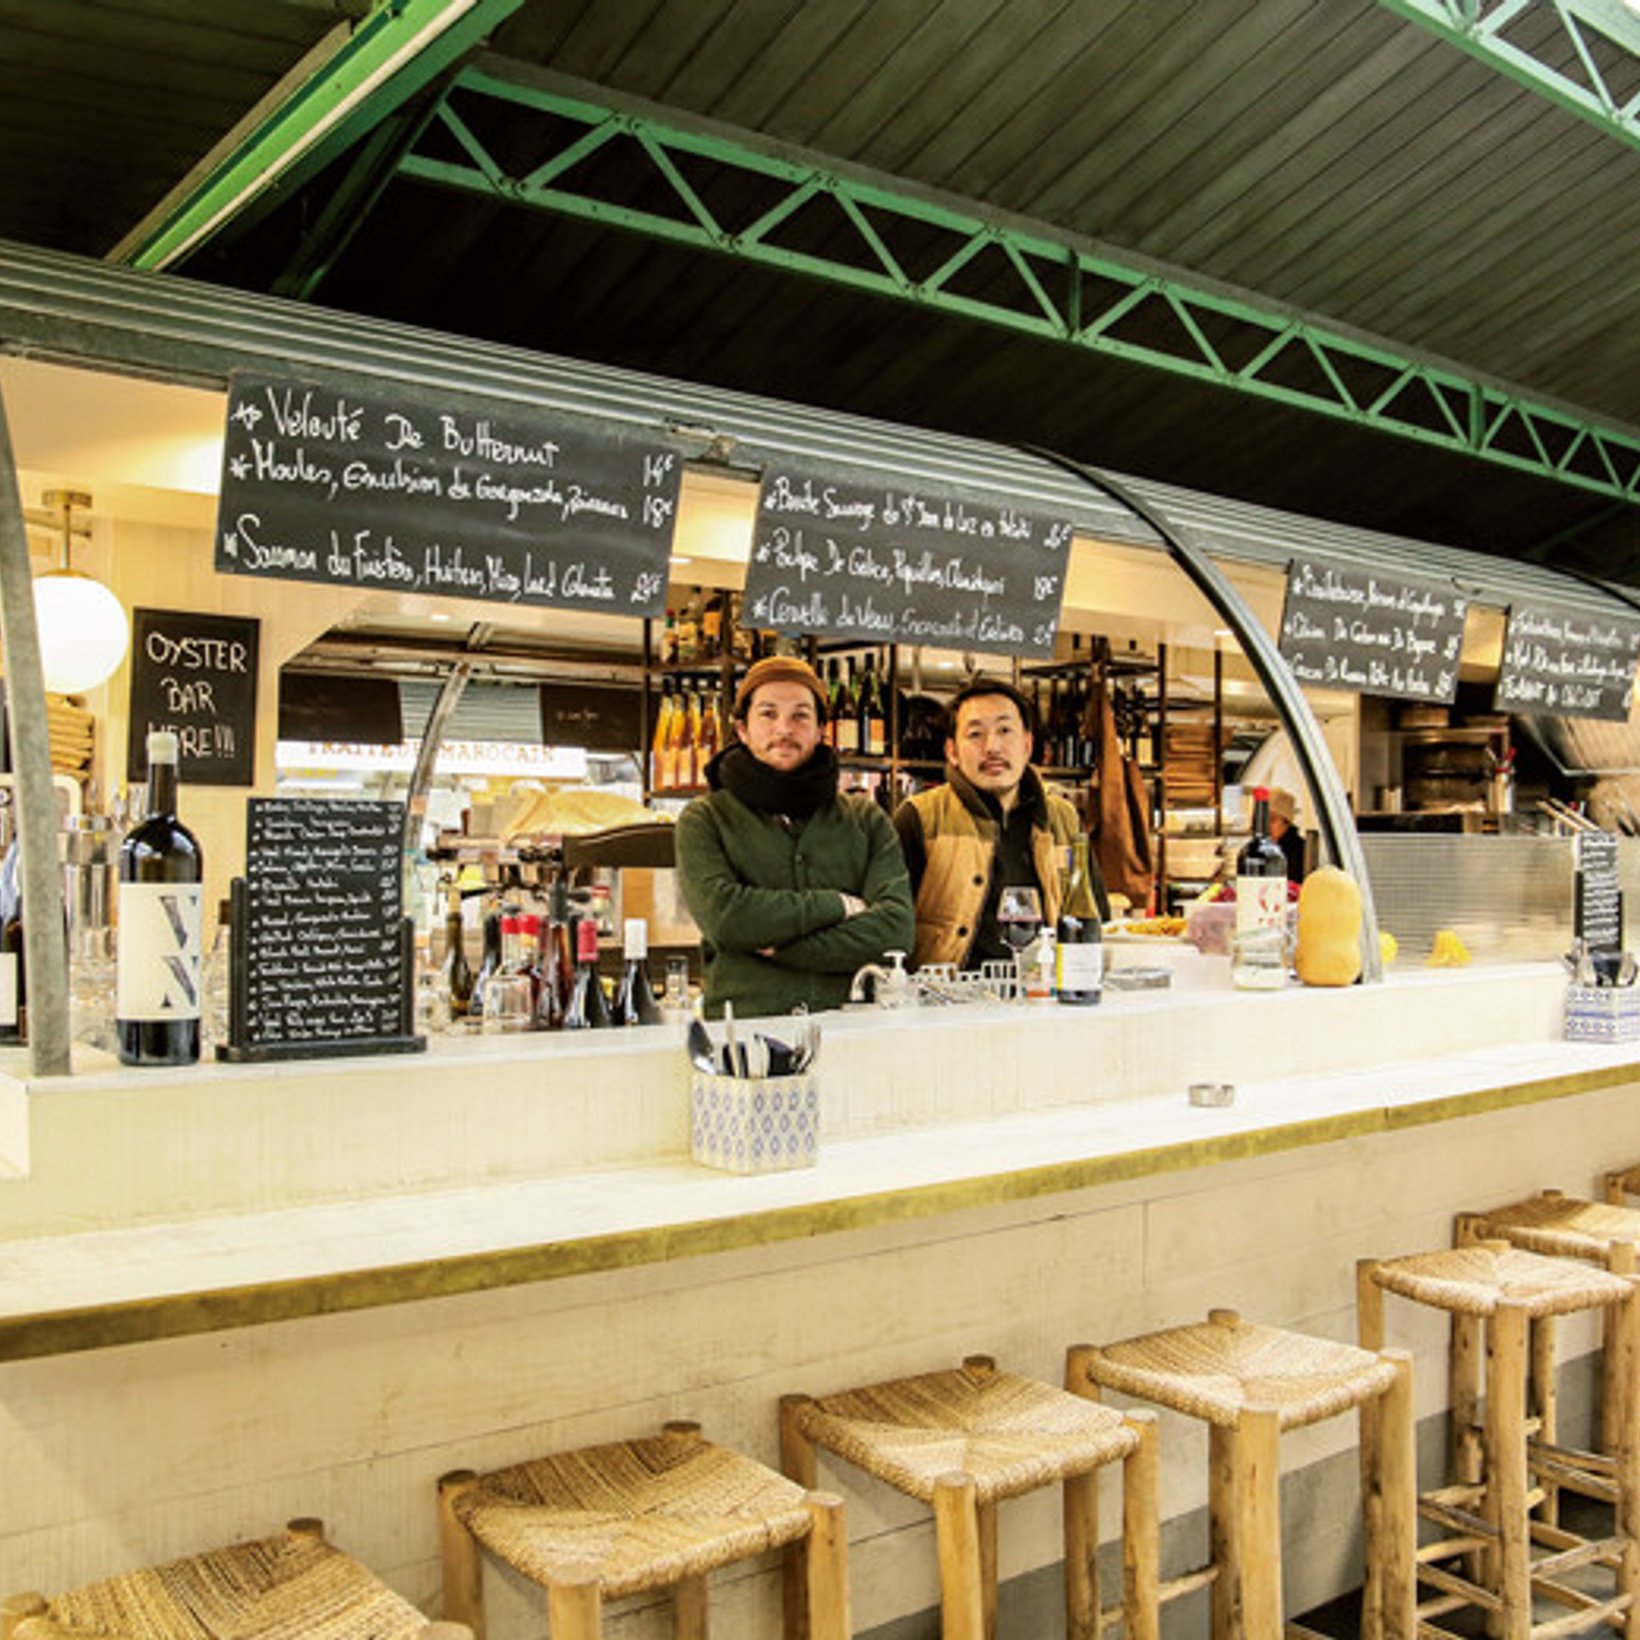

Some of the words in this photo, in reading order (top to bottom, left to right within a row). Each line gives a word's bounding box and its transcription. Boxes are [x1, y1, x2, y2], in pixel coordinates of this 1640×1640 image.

[266, 386, 364, 441] Velouté
[384, 413, 425, 449] De
[440, 415, 560, 467] Butternut
[146, 631, 247, 674] OYSTER
[160, 677, 217, 714] BAR
